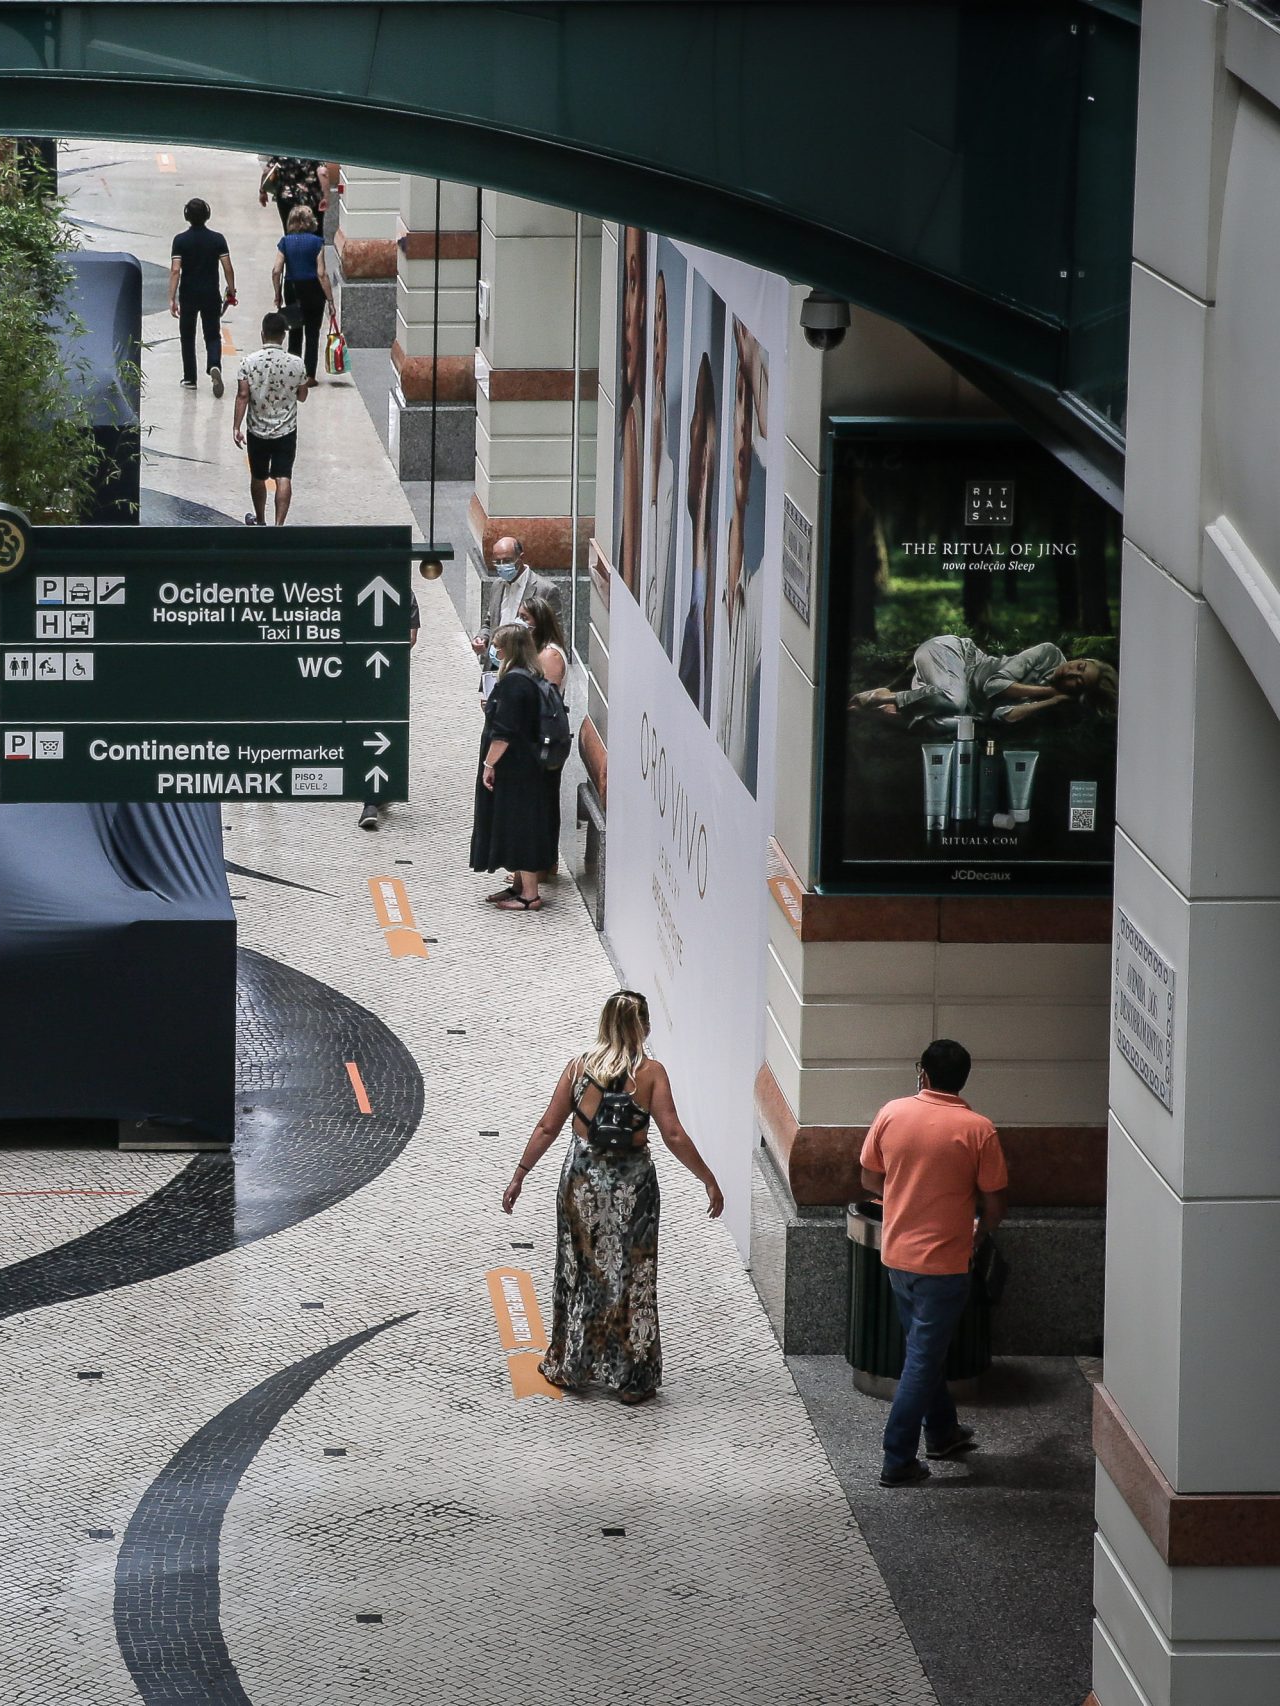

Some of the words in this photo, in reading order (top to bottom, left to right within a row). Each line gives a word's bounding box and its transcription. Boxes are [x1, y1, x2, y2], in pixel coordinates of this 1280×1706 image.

[901, 542, 938, 556] THE
[942, 542, 1005, 556] RITUAL
[1010, 542, 1033, 556] OF
[1037, 542, 1078, 558] JING
[941, 562, 967, 571] nova
[968, 560, 1007, 572] coleção
[1008, 560, 1036, 572] Sleep
[158, 582, 275, 604] Ocidente
[282, 582, 343, 603] West
[153, 607, 225, 626] Hospital
[240, 607, 267, 622] Av.
[272, 607, 341, 622] Lusiada
[258, 625, 290, 640] Taxi
[306, 625, 341, 640] Bus
[297, 656, 343, 678] WC
[89, 739, 231, 761] Continente
[238, 745, 345, 764] Hypermarket
[157, 773, 284, 794] PRIMARK
[294, 773, 316, 781] PISO
[317, 773, 324, 781] 2
[294, 782, 321, 790] LEVEL
[322, 782, 328, 790] 2
[941, 836, 1019, 846] RITUALS.COM
[951, 869, 1012, 880] JCDecaux
